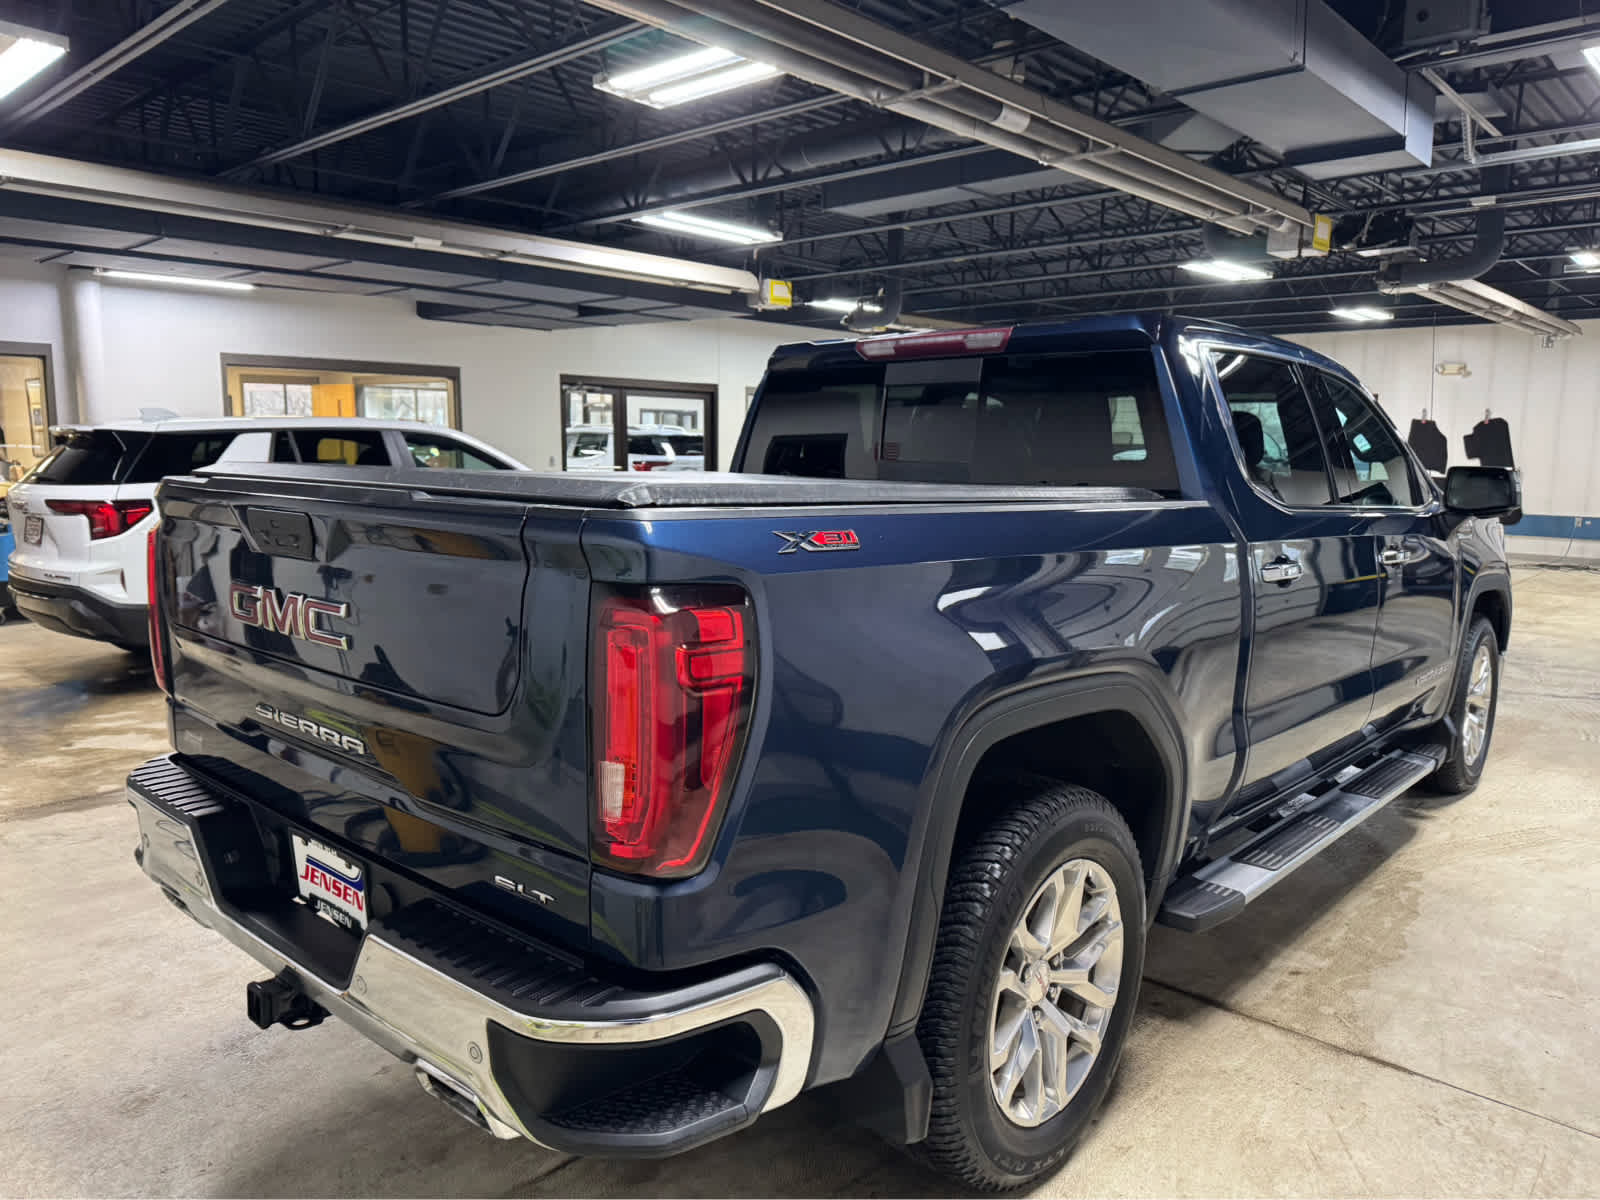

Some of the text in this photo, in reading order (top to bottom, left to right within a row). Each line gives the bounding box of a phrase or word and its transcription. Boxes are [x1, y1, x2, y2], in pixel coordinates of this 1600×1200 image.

[229, 583, 348, 651] GMC
[255, 704, 365, 755] SIERRA
[300, 863, 364, 912] JENSEN
[494, 875, 555, 904] SLT
[314, 899, 352, 929] JENSEN
